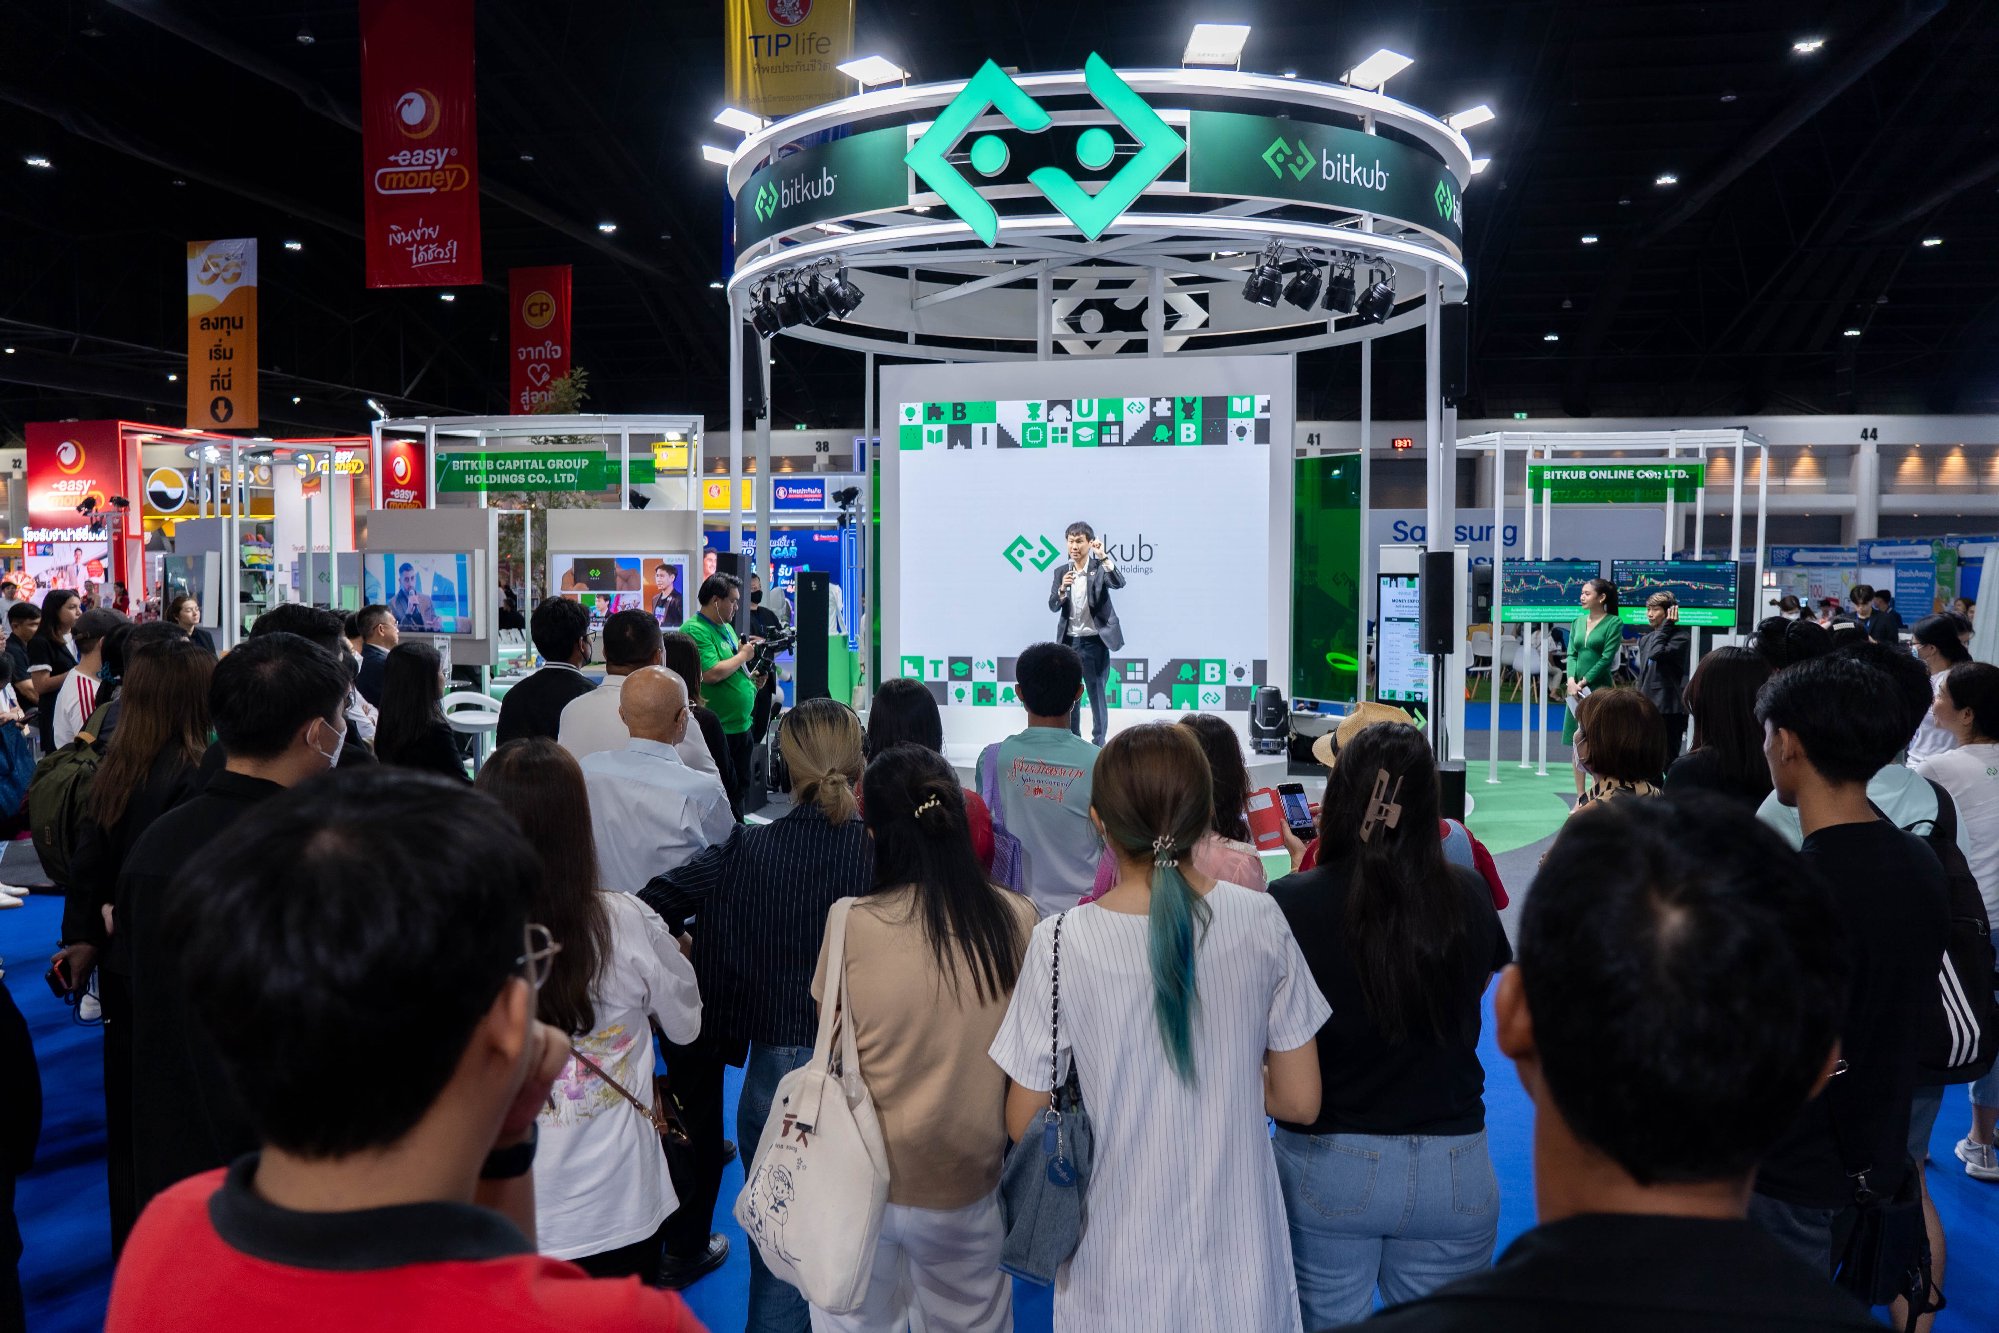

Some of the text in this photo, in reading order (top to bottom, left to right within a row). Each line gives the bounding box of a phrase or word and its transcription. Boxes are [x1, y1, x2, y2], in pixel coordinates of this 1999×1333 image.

[397, 147, 449, 170] easy
[1322, 148, 1387, 191] bitkub
[384, 170, 458, 192] money
[781, 167, 835, 208] bitkub
[527, 302, 550, 317] CP
[200, 315, 244, 336] ลงทุน
[209, 338, 233, 361] เริ่ม
[518, 340, 562, 360] จากใจ
[210, 367, 232, 391] ที่นี่
[1307, 433, 1321, 446] 41
[1860, 427, 1878, 441] 44
[815, 441, 830, 452] 38
[1394, 439, 1412, 449] 13:37
[452, 458, 589, 471] BITKUB CAPITAL GROUP
[465, 473, 578, 485] HOLDINGS CO., LTD.
[1543, 470, 1586, 480] BITKUB
[1589, 470, 1634, 479] ONLINE
[1664, 469, 1689, 479] LTD.
[59, 479, 91, 495] easy
[394, 489, 415, 503] easy
[772, 546, 798, 559] CAR
[778, 564, 792, 577] รับ
[1120, 565, 1154, 575] Holdings
[1897, 569, 1932, 579] StashAway
[1810, 584, 1822, 598] 100
